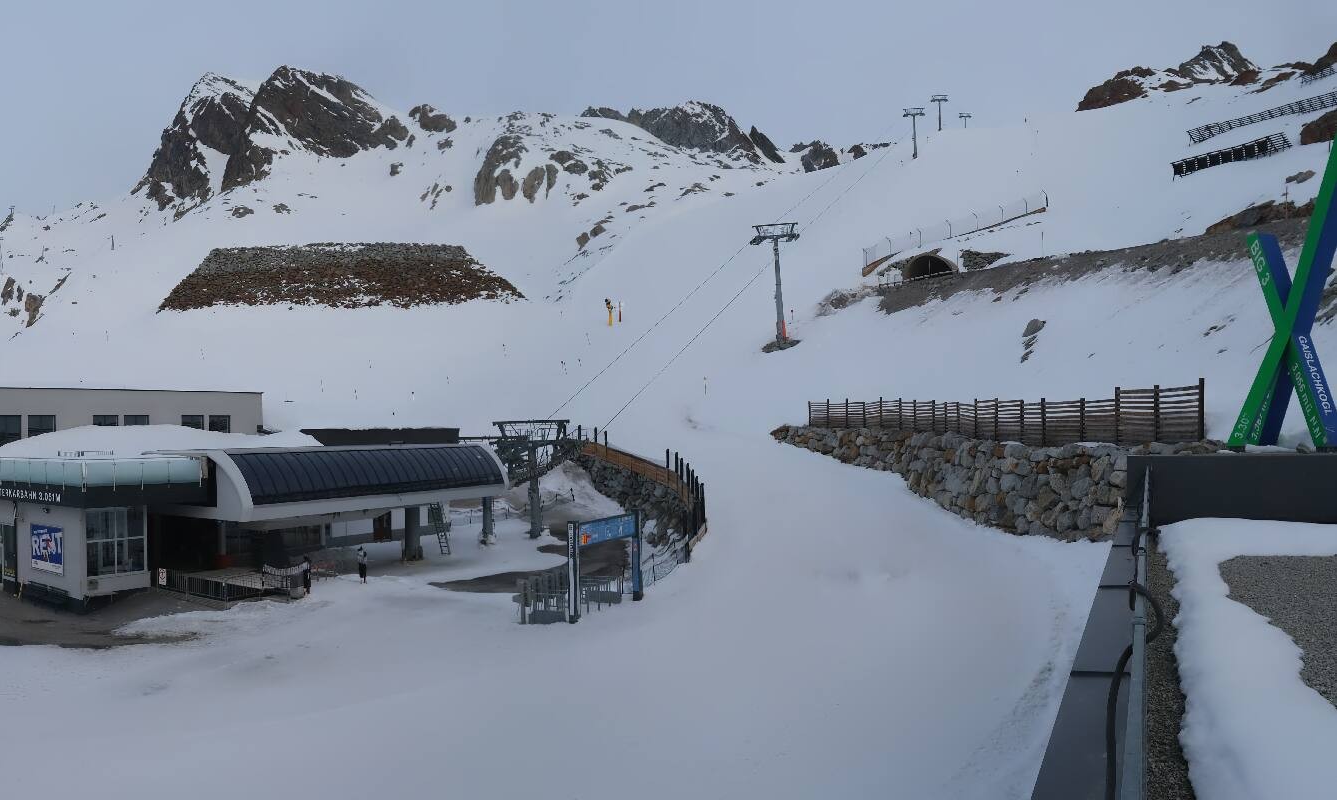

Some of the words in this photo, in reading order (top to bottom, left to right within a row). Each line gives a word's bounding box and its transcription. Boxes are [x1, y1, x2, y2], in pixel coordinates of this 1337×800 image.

[1251, 240, 1266, 272] BIG
[1262, 273, 1270, 286] 3
[1298, 336, 1333, 416] GAISLACHKOGL
